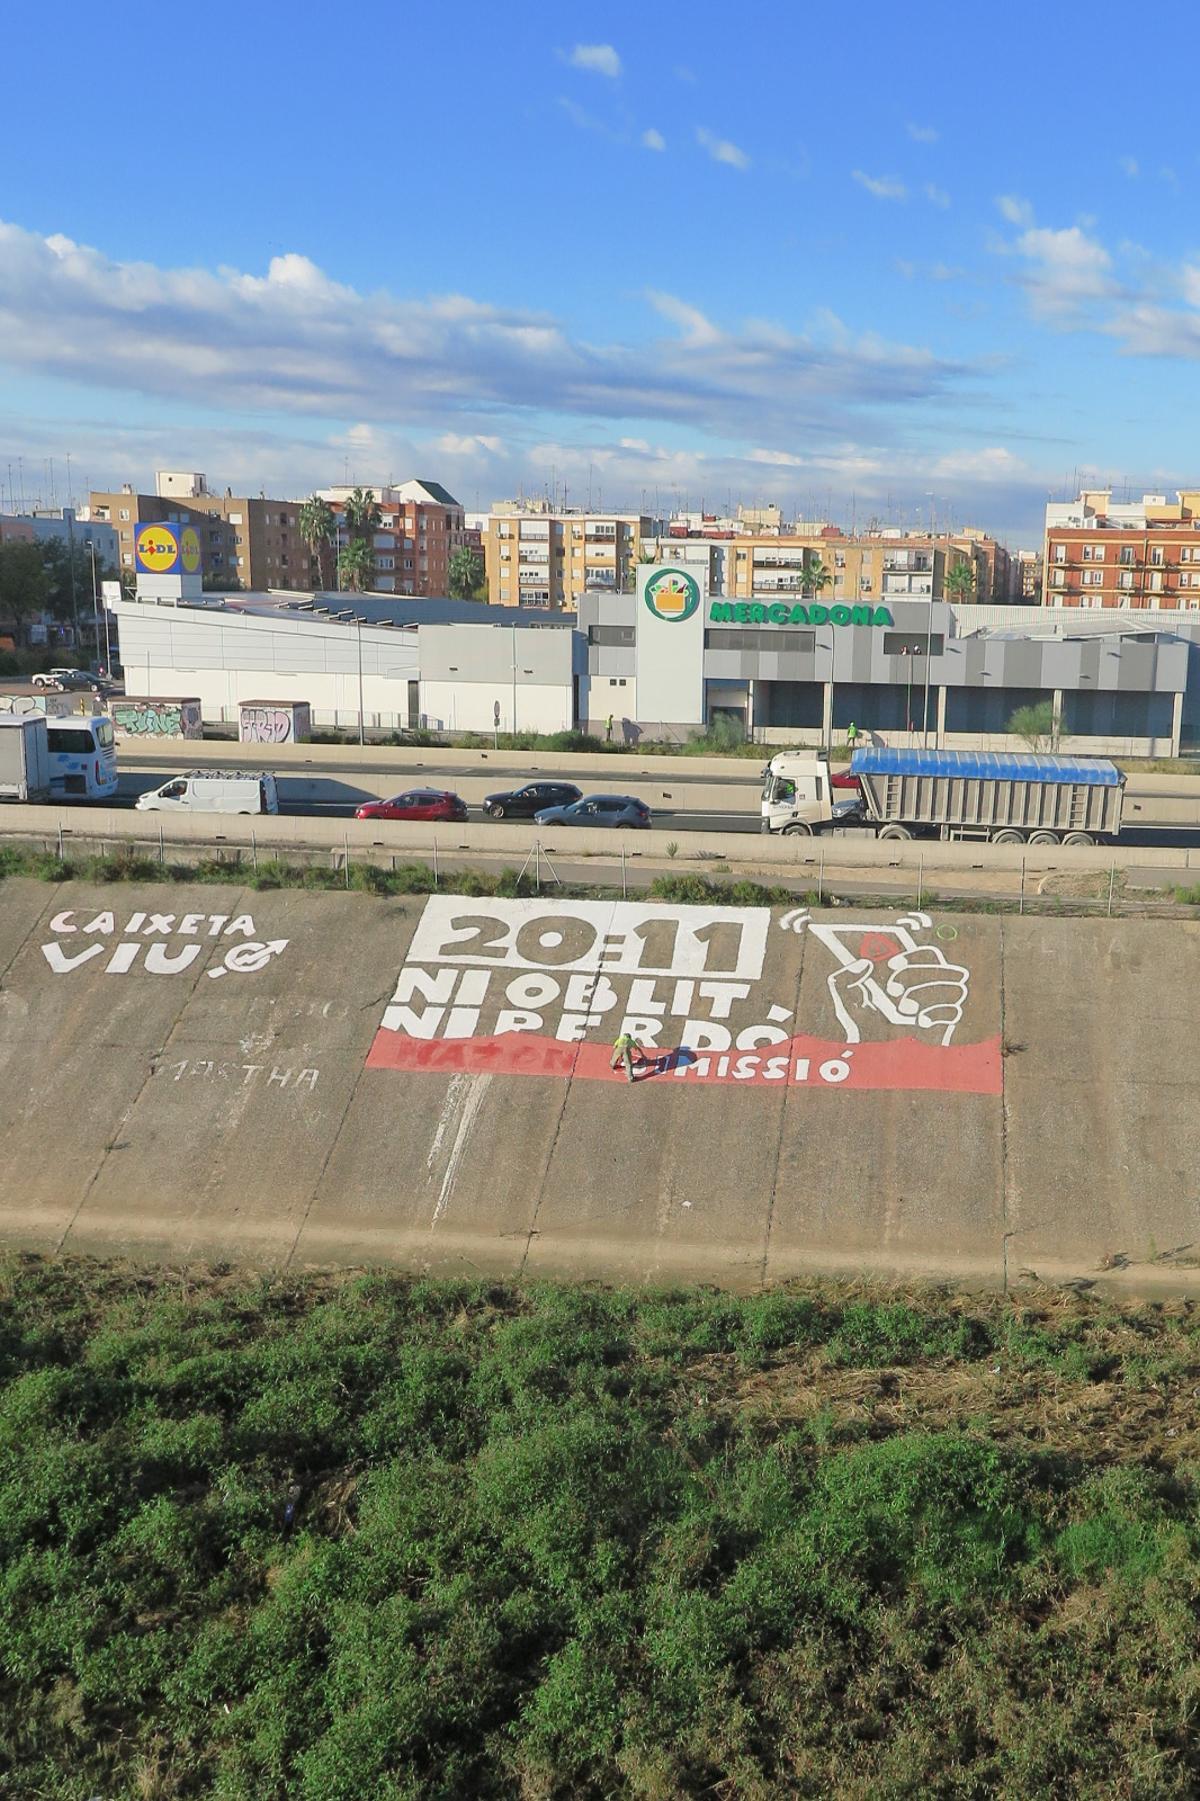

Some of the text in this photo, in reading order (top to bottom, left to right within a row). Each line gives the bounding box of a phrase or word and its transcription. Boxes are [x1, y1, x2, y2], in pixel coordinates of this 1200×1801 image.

[139, 540, 176, 555] LIDL
[709, 602, 894, 627] MERCADONA
[50, 911, 256, 936] CAIXETA
[41, 942, 201, 974] VIU
[438, 914, 745, 973] 20:11
[390, 967, 752, 1019] NI OBLIT
[380, 1005, 481, 1040] NI
